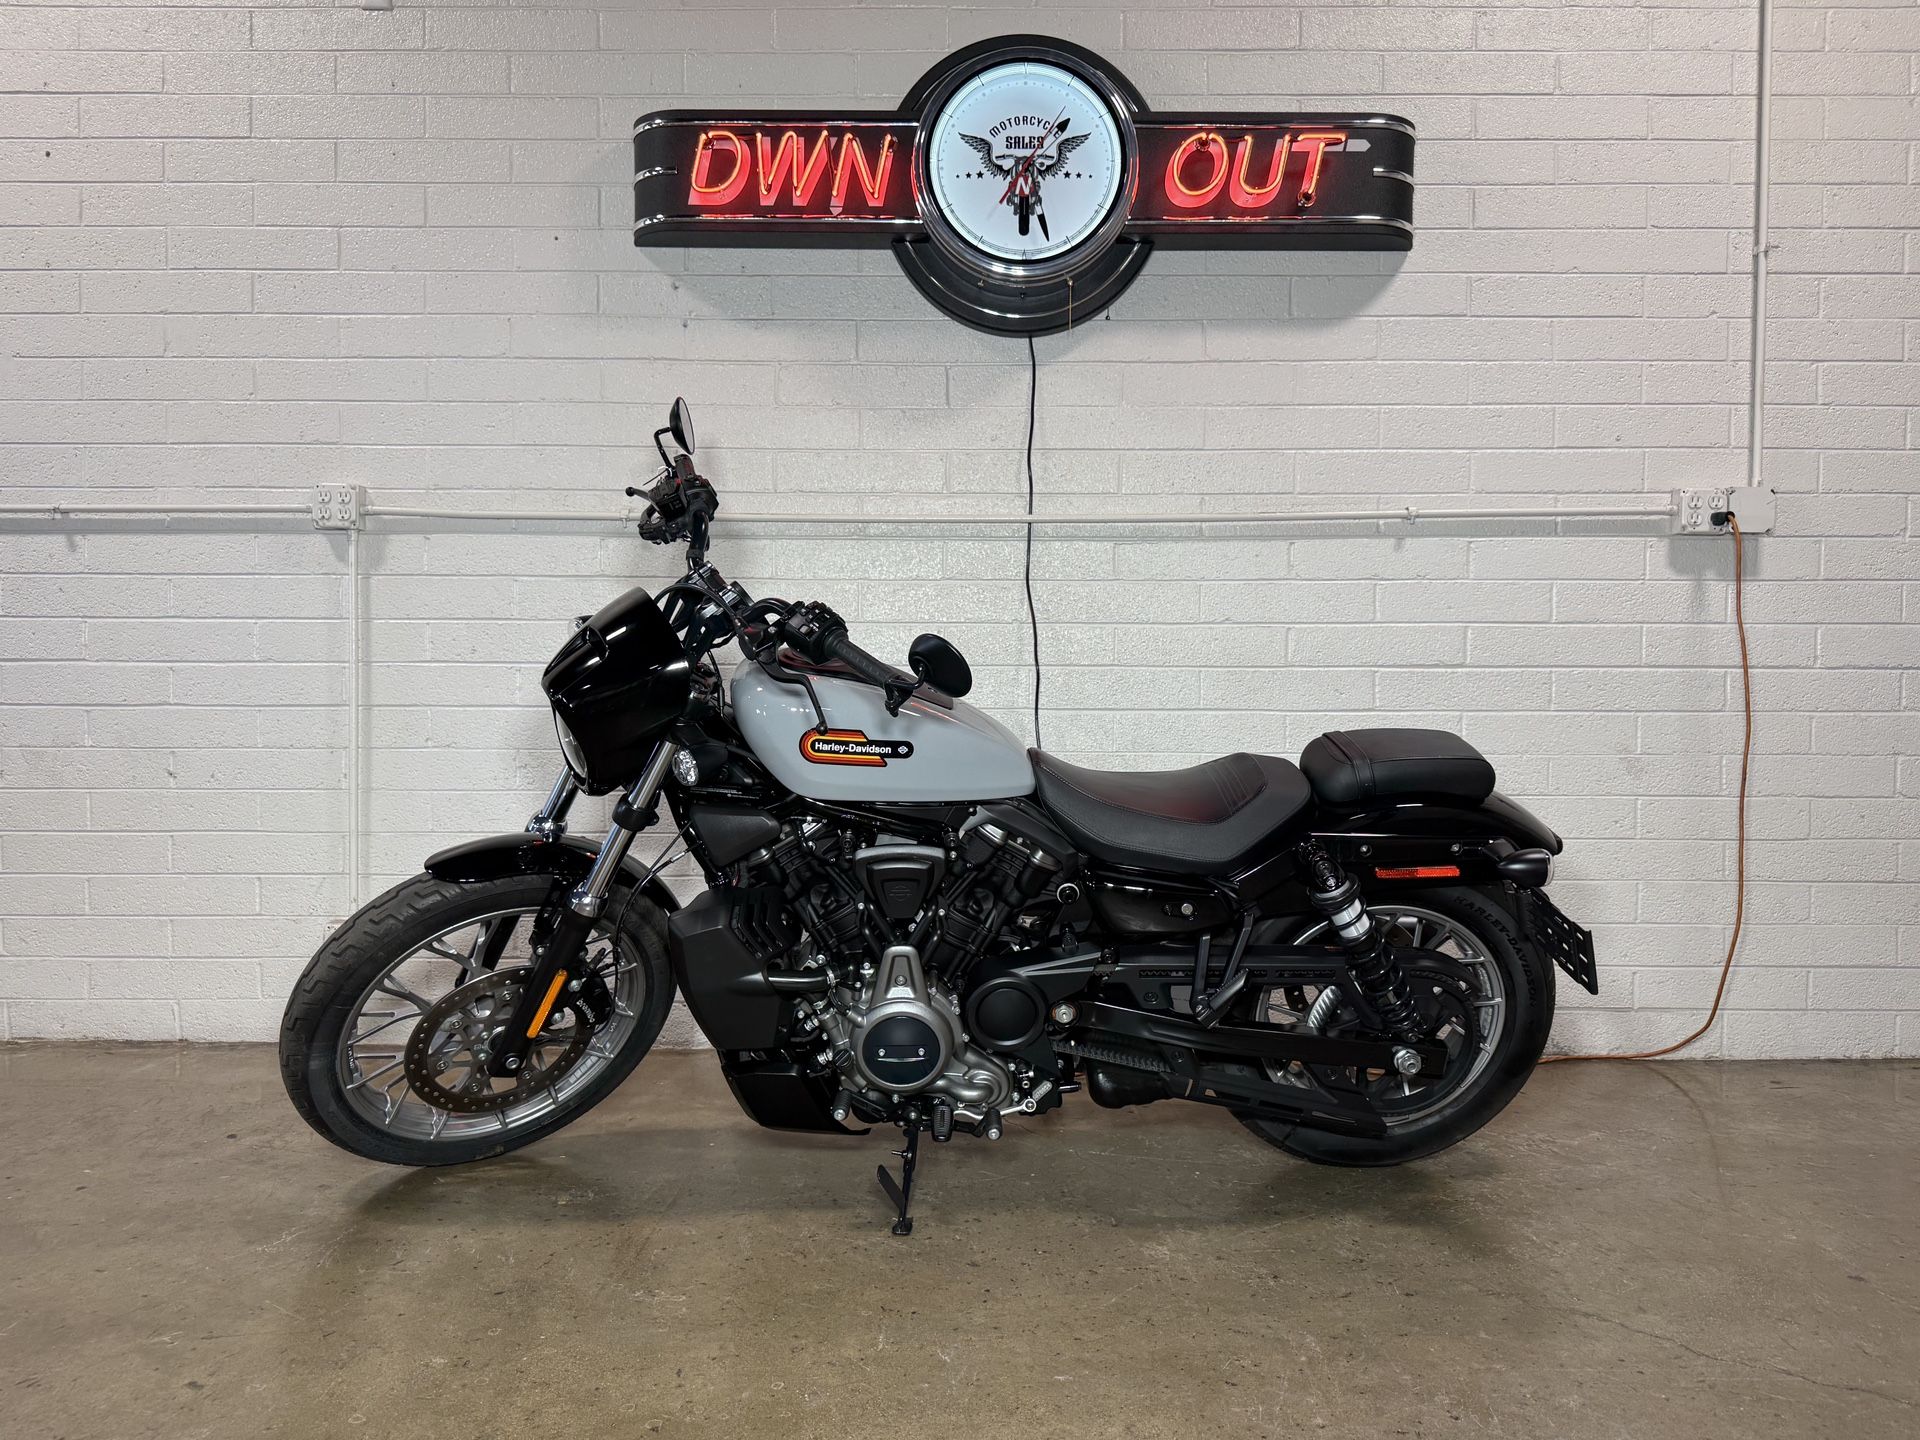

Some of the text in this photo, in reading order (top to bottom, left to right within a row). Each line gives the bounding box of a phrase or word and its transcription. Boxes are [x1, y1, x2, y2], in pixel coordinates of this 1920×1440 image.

[989, 115, 1062, 138] MOTORCYCE
[1005, 136, 1044, 149] SALES
[688, 130, 1347, 208] DWN OUT
[815, 742, 891, 754] Harley-Davidson
[1454, 896, 1537, 1008] HARLEY-DAVIDSON
[576, 997, 596, 1023] brembo
